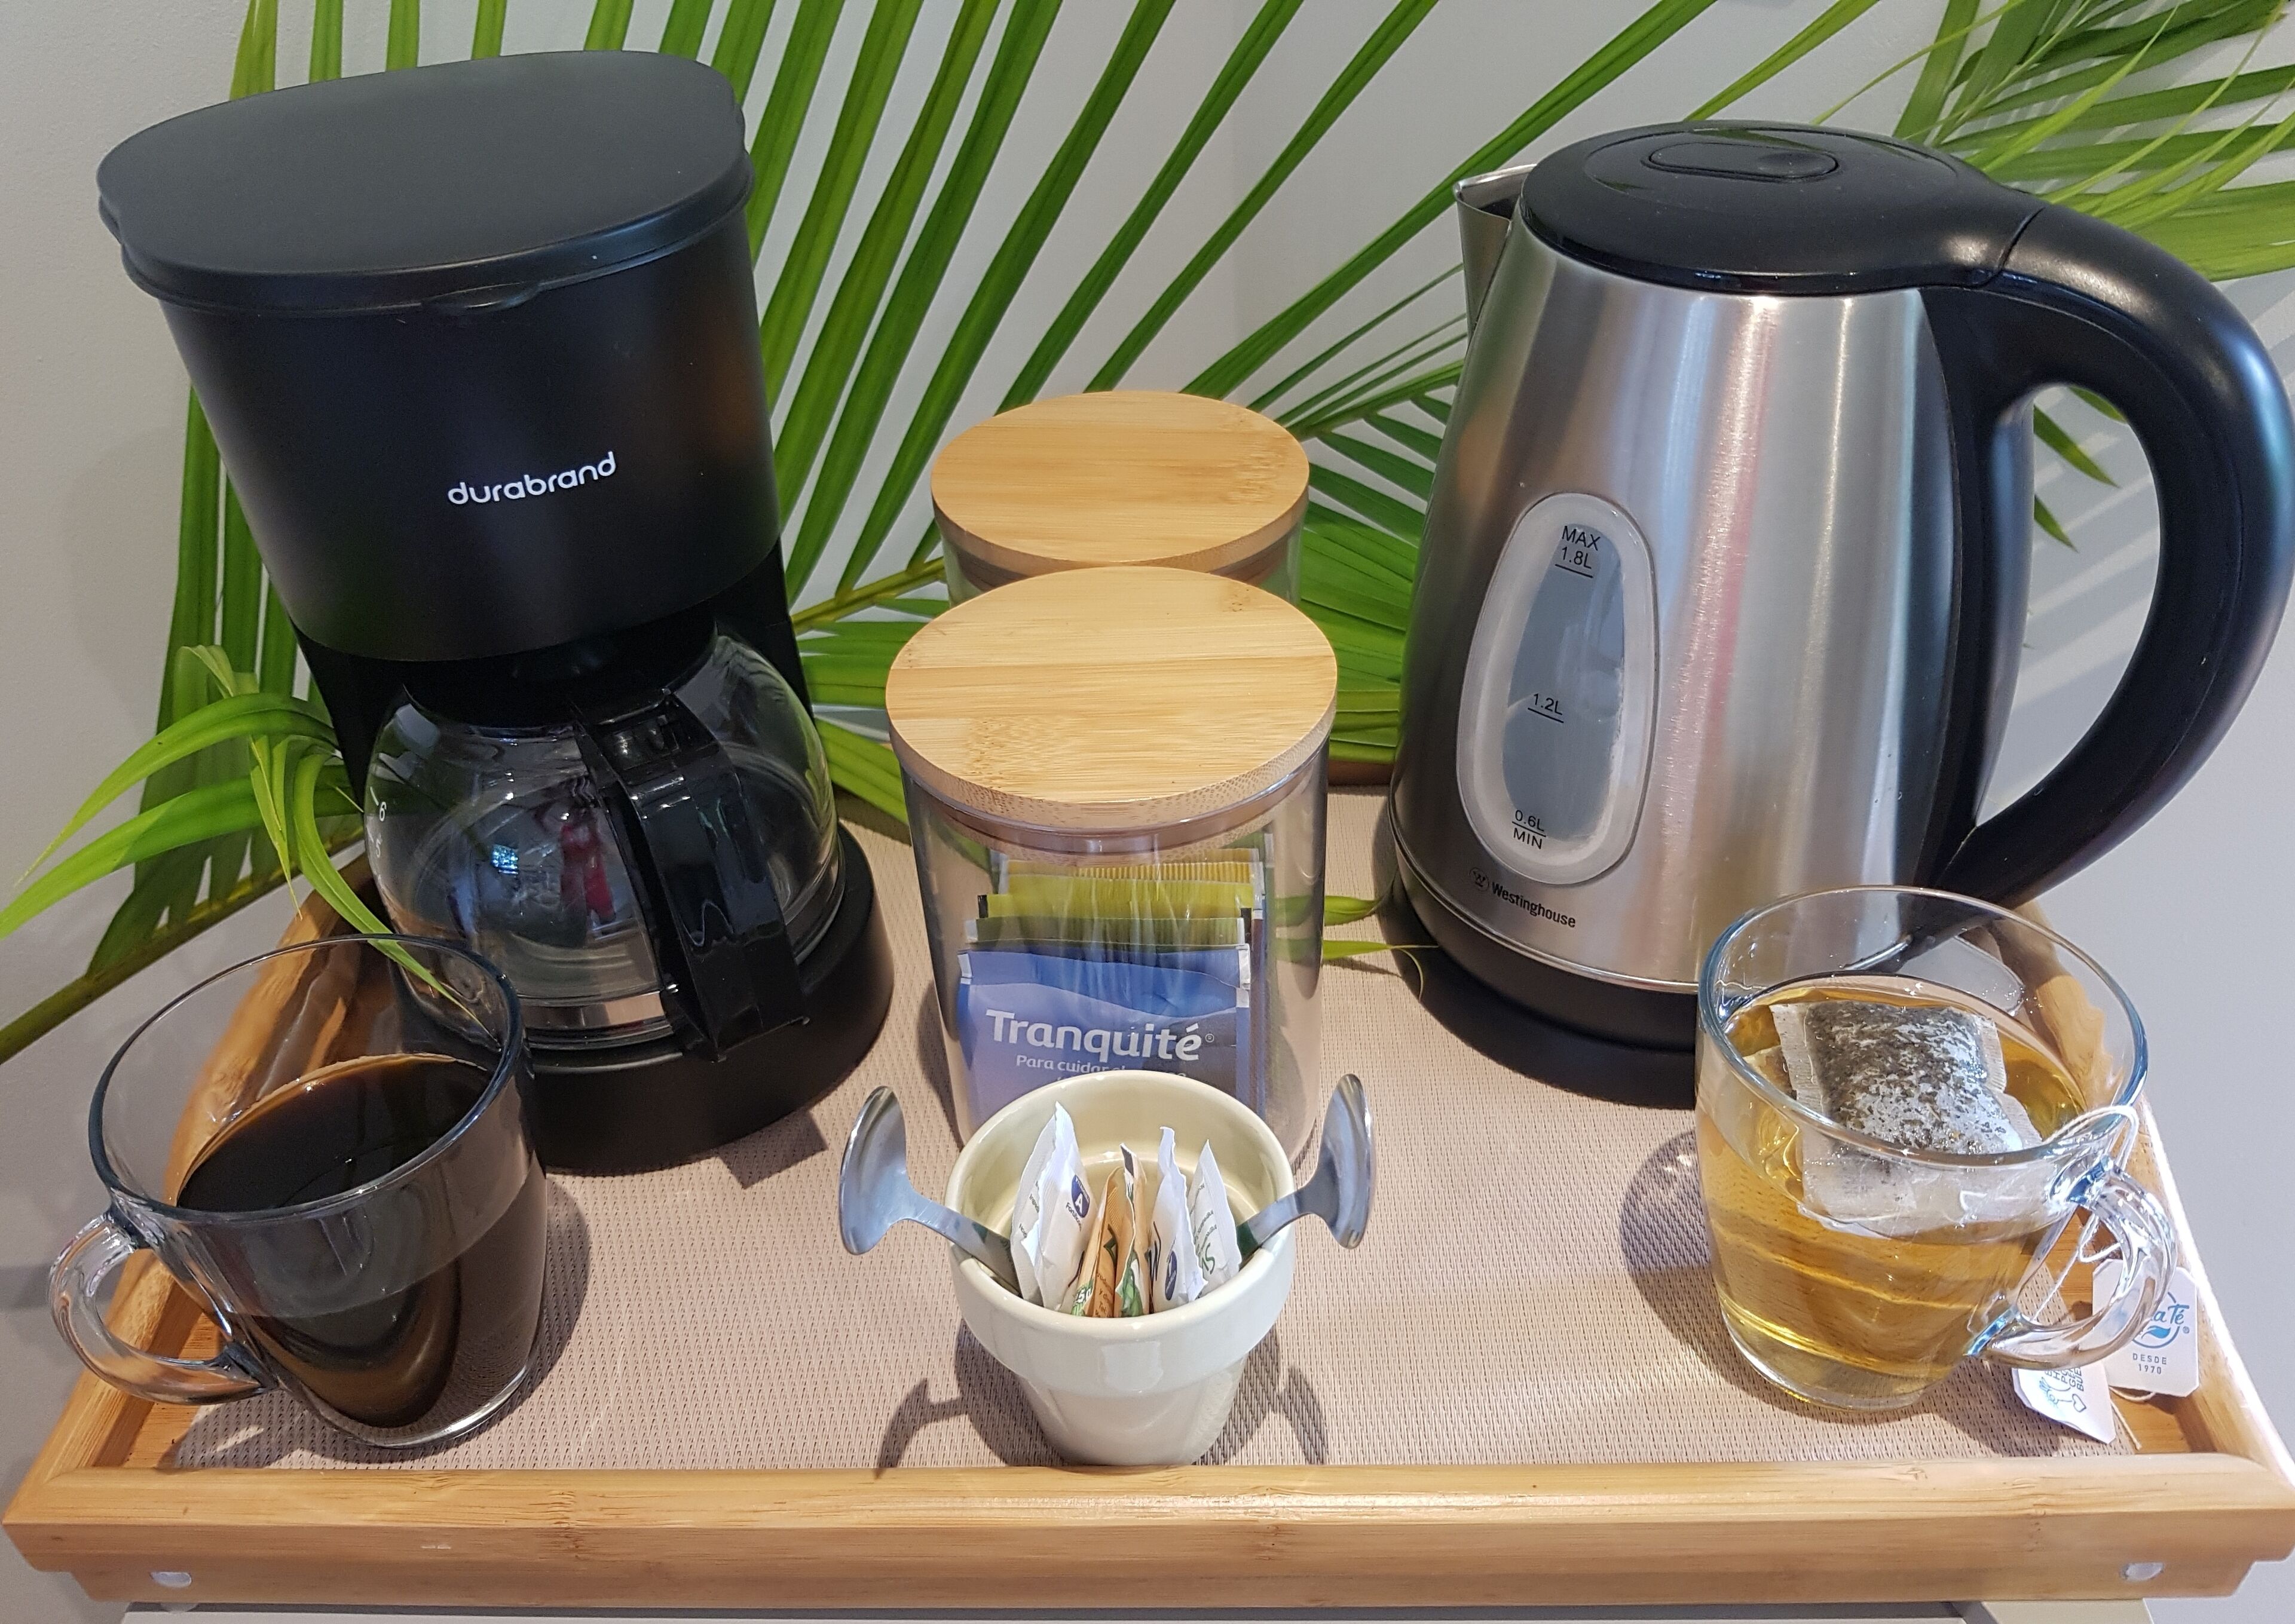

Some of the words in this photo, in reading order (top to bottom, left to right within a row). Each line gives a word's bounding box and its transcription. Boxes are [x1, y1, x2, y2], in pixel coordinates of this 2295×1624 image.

[448, 451, 616, 505] durabrand
[1562, 525, 1601, 551] MAX
[1562, 546, 1592, 569] 1.8L
[1534, 693, 1563, 716] 1.2L
[379, 801, 387, 822] 6
[1515, 810, 1545, 832] 0.6L
[1513, 828, 1543, 850] MIN
[1492, 881, 1576, 928] Westinghouse
[1016, 1054, 1054, 1070] Para
[2132, 1353, 2167, 1365] DESDE
[2139, 1363, 2162, 1375] 1970
